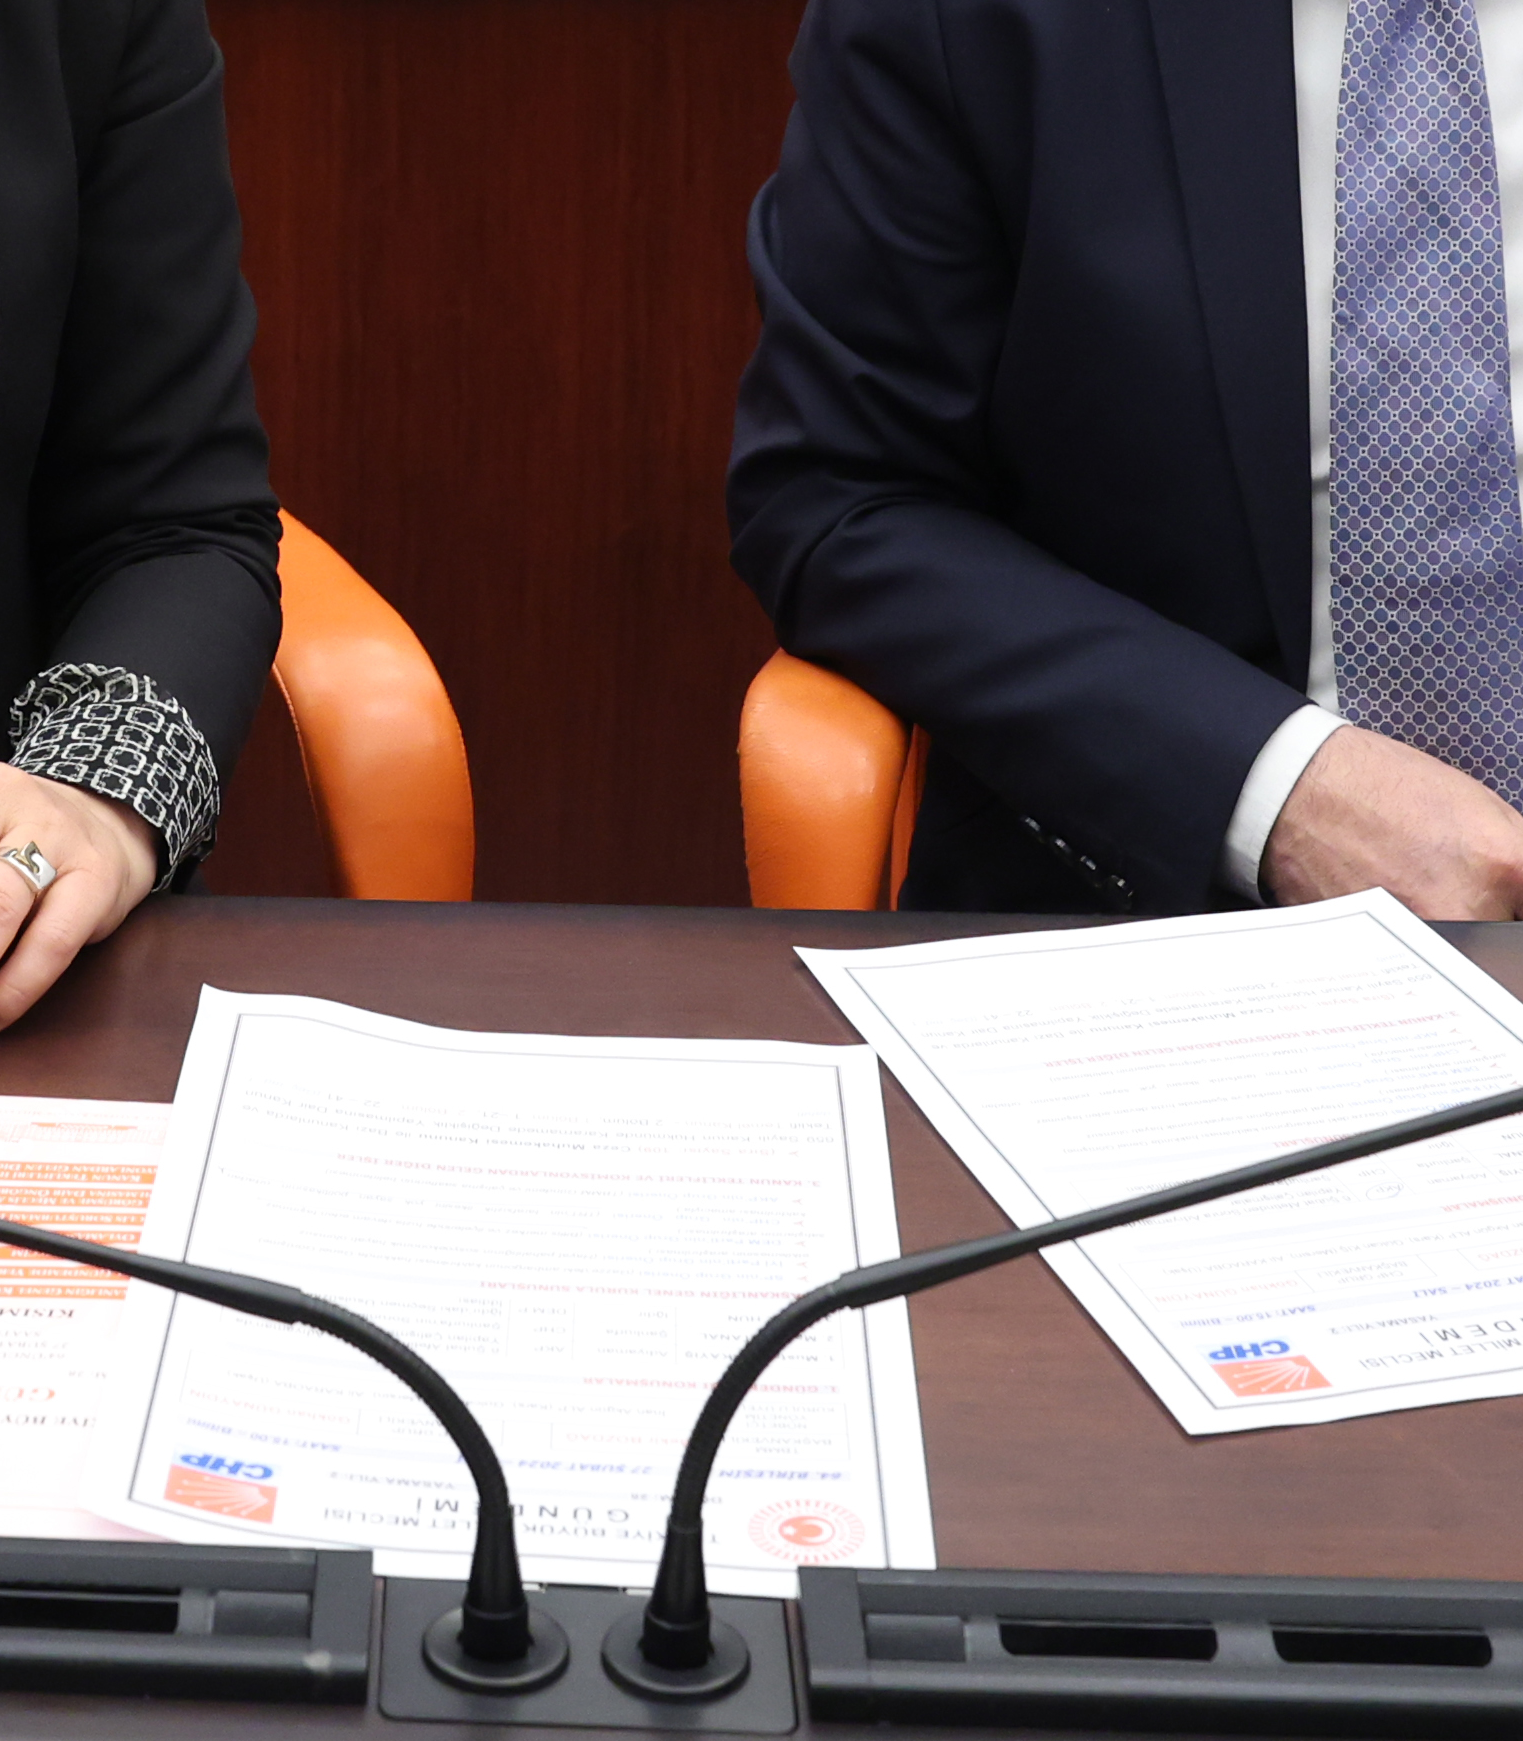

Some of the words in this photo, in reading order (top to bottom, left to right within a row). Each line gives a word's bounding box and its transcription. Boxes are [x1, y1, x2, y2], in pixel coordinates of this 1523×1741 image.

[1464, 1278, 1501, 1292] 2024
[1207, 1339, 1290, 1361] CHP
[1448, 1337, 1521, 1358] MİLLET
[1358, 1347, 1445, 1370] MECLİSİ
[179, 1453, 274, 1481] CHP
[323, 1507, 419, 1527] MECLİSİ
